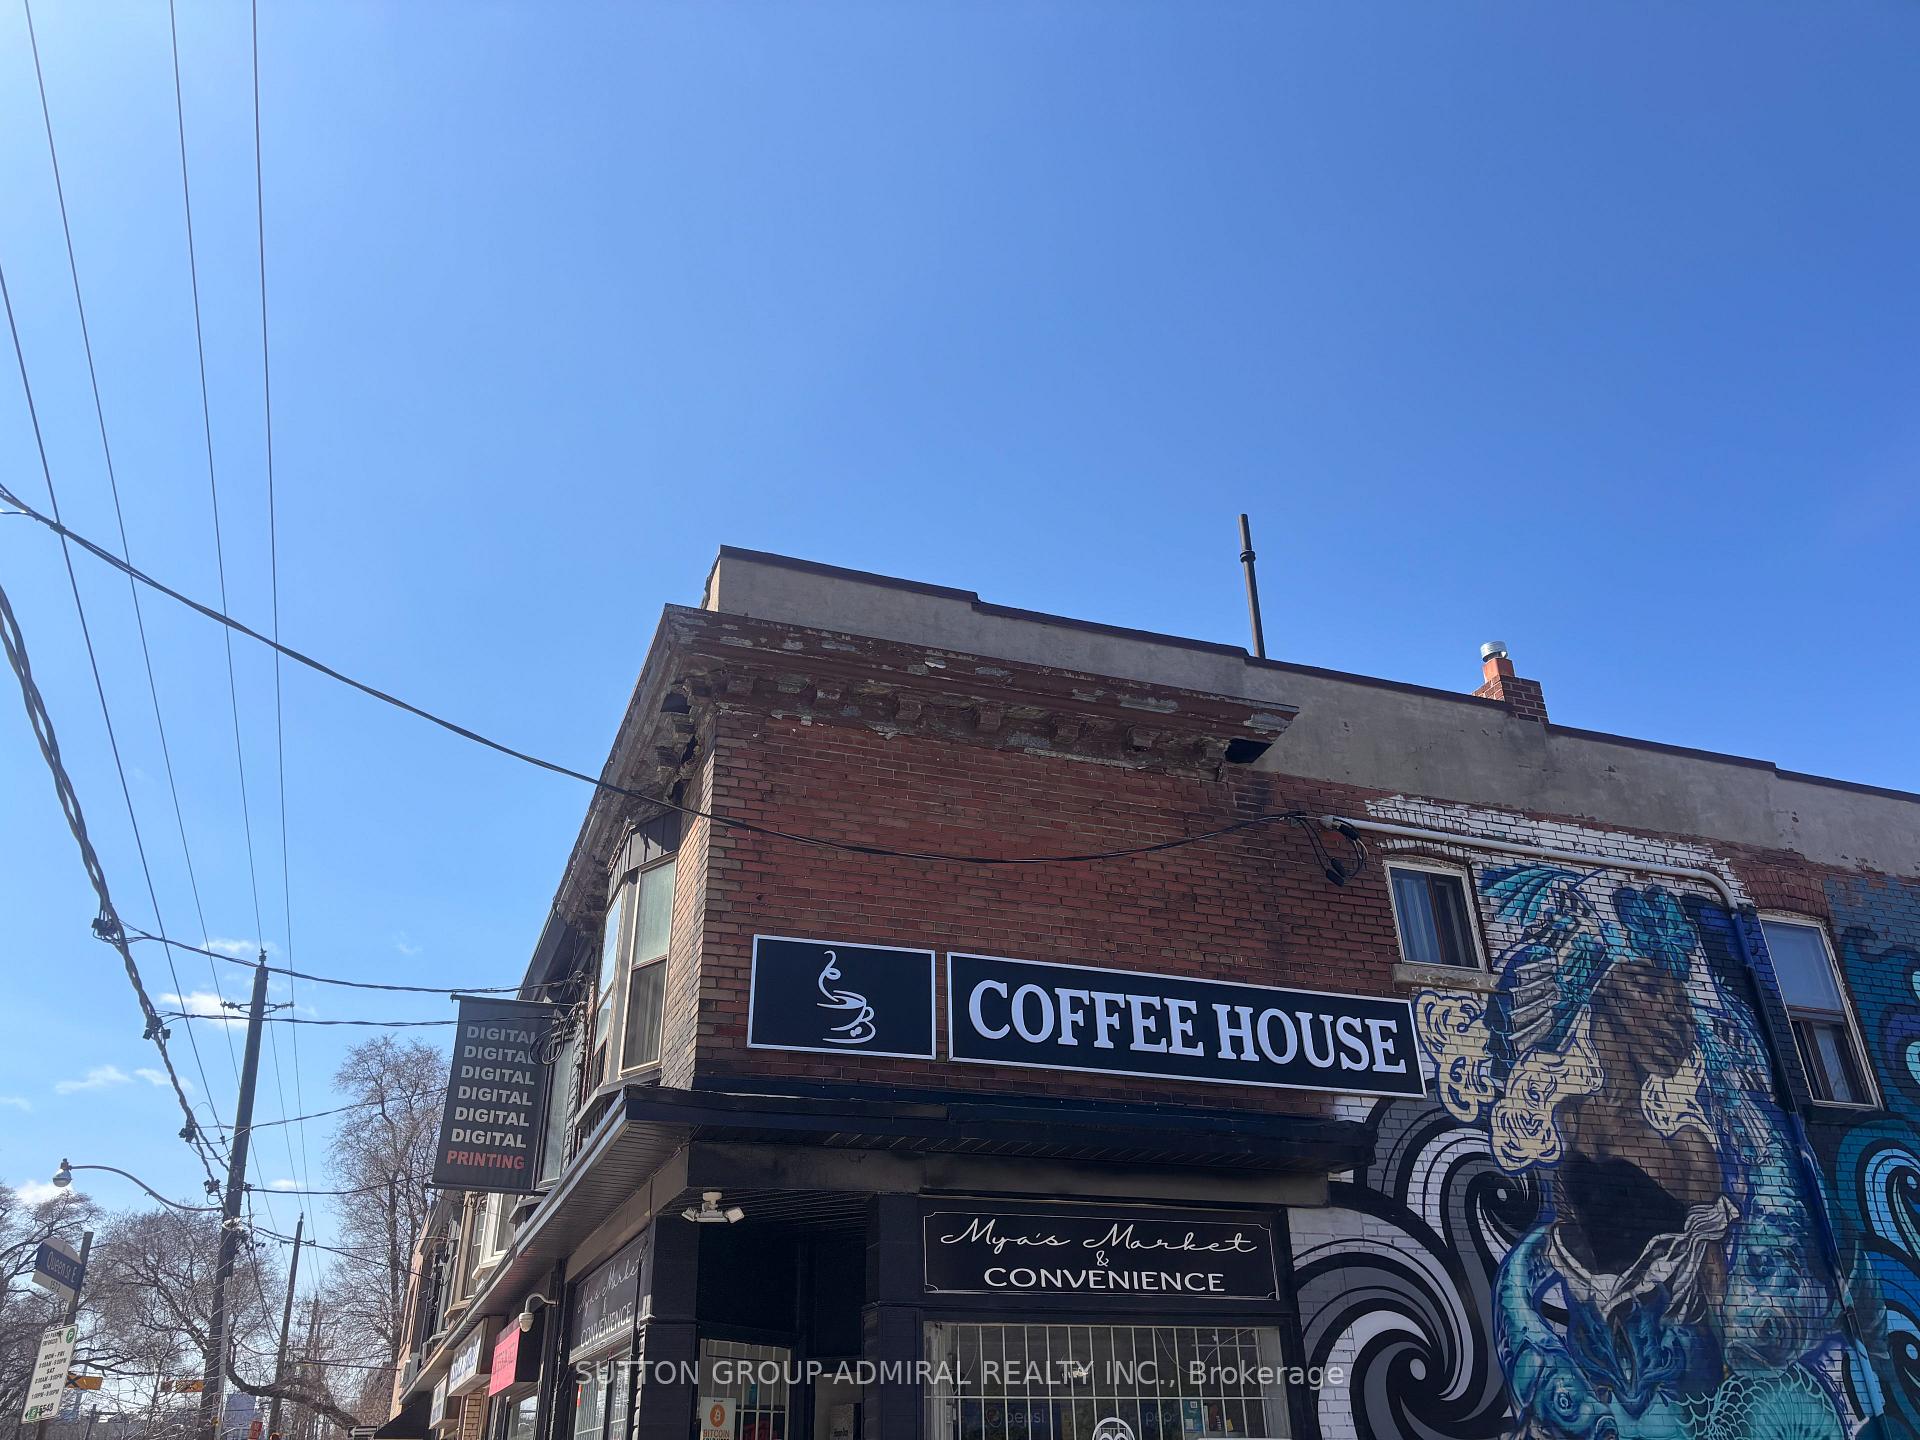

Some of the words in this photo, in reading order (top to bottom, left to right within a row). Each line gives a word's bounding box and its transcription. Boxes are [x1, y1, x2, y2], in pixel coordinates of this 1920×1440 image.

[968, 979, 1205, 1057] COFFEE
[1212, 1003, 1407, 1073] HOUSE
[464, 1045, 536, 1064] DIGITAL
[461, 1065, 535, 1085] DIGITAL
[458, 1086, 532, 1106] DIGITAL
[454, 1106, 530, 1127] DIGITAL
[451, 1128, 527, 1149] DIGITAL
[447, 1150, 525, 1170] PRINTING
[941, 1218, 1070, 1254] Mya's
[1083, 1224, 1258, 1252] Market
[47, 1251, 65, 1276] Queen
[1096, 1250, 1109, 1266] &
[984, 1267, 1225, 1292] CONVENIENCE
[580, 1302, 632, 1347] CONVENIENCE
[703, 1429, 730, 1438] BITCOIN
